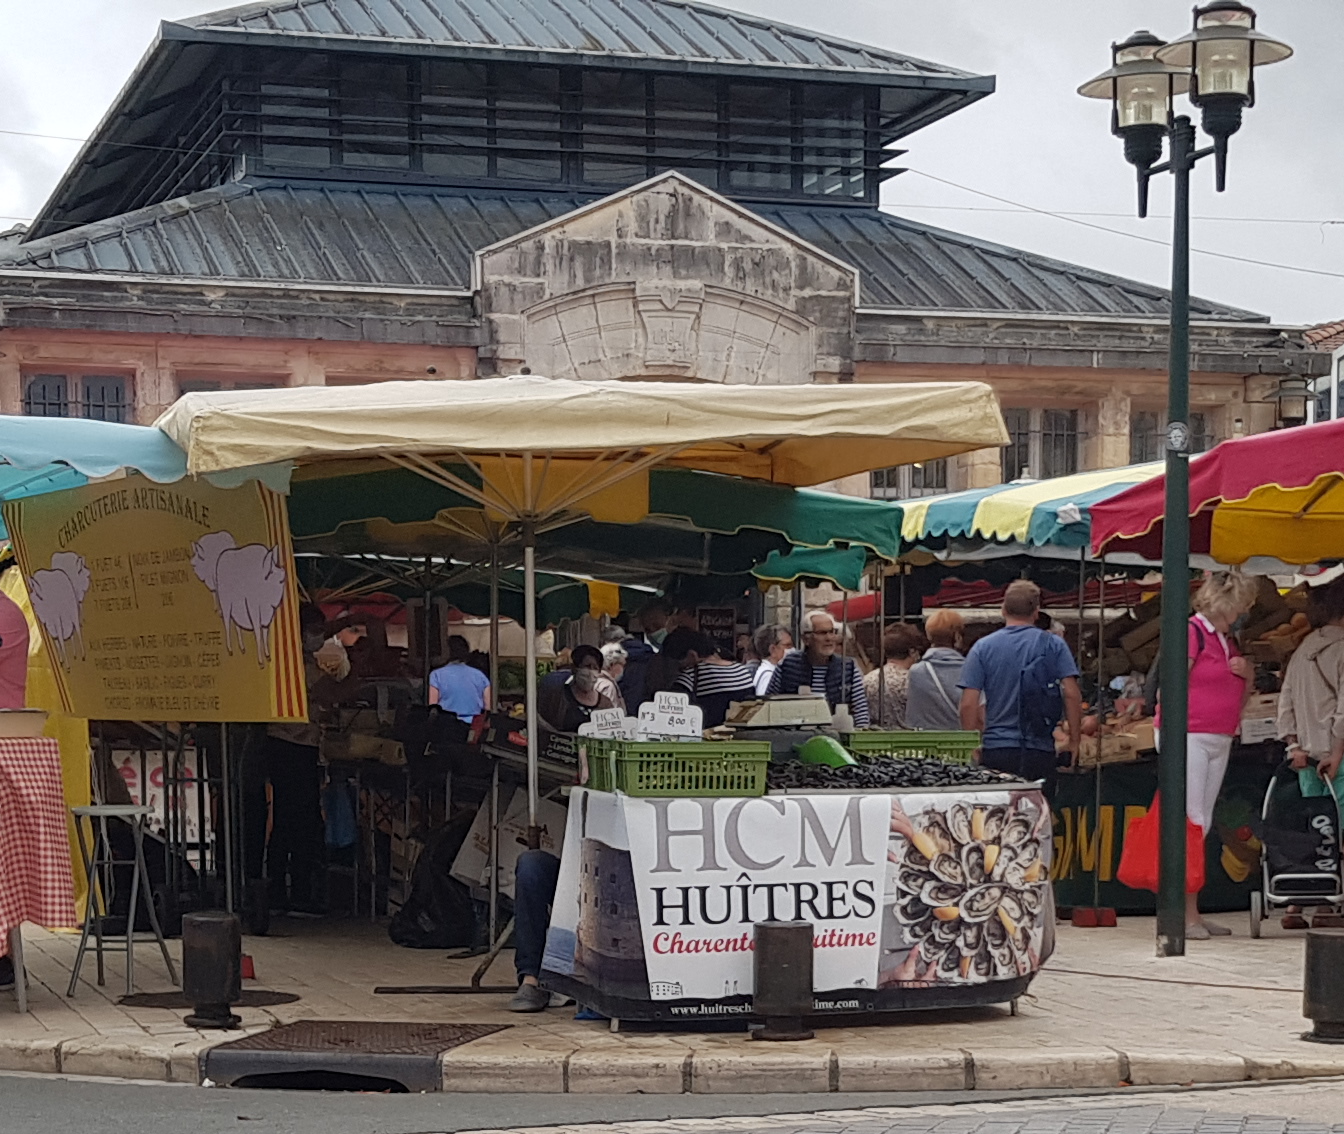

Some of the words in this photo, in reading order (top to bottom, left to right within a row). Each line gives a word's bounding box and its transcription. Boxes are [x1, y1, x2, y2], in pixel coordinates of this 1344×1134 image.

[58, 488, 129, 548] CHARCUTERIE
[133, 488, 210, 528] ARTISANALE
[644, 796, 875, 873] HCM
[650, 872, 876, 926] HUÎTRES
